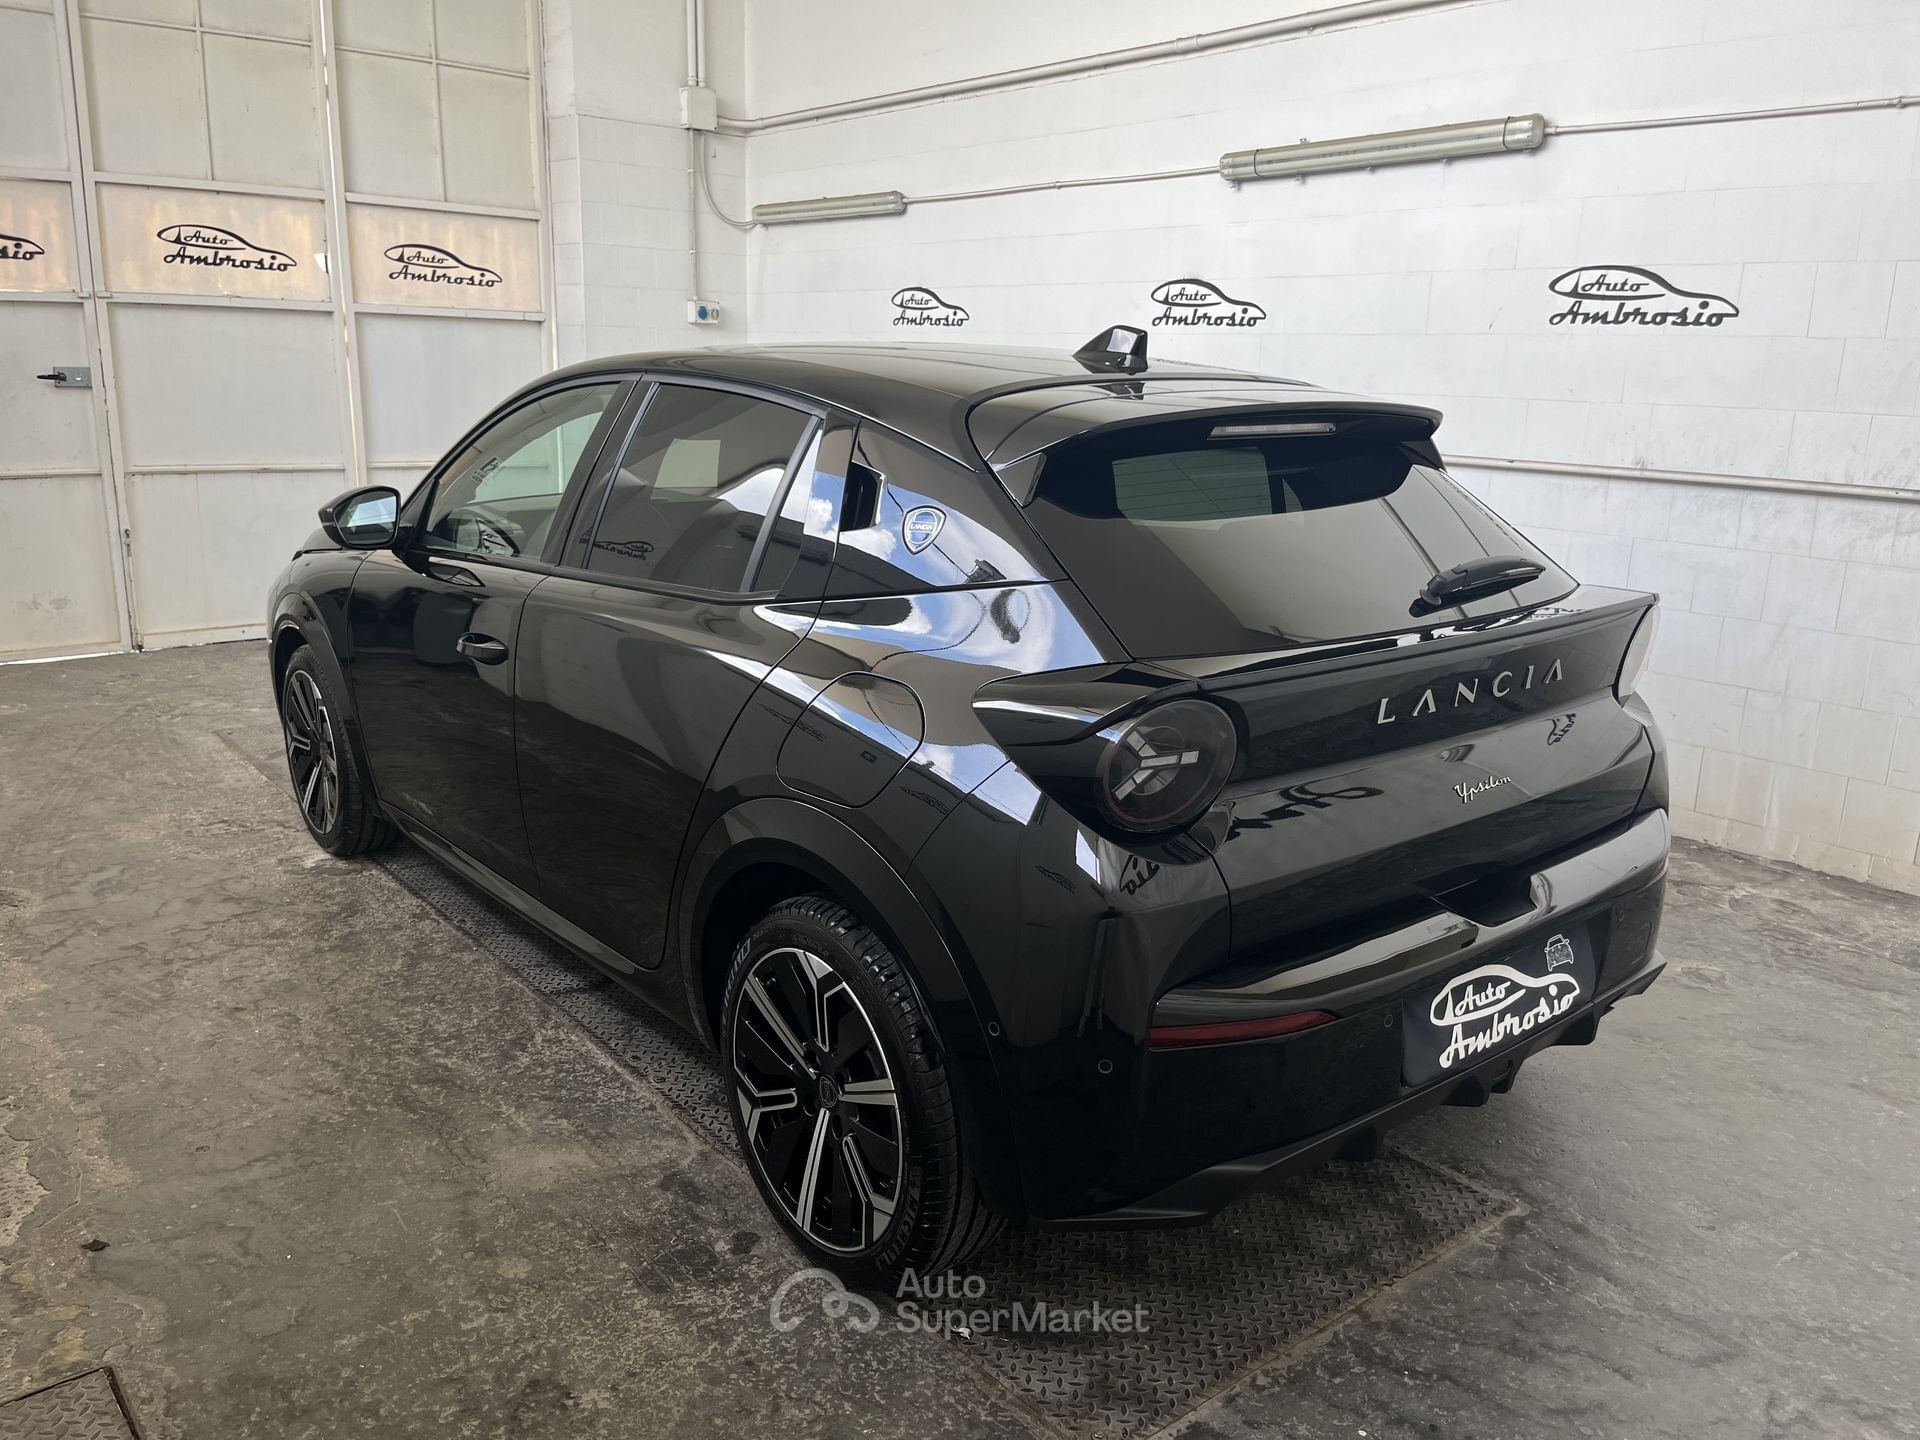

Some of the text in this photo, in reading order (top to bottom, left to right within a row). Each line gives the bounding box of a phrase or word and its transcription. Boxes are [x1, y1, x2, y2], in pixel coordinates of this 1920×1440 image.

[183, 230, 233, 246] Auto
[163, 246, 292, 272] Ambrosio
[406, 251, 449, 265] Auto
[388, 265, 498, 287] Ambrosio
[1580, 273, 1650, 292] Auto
[904, 293, 932, 306] Auto
[1170, 287, 1212, 302] Auto
[892, 309, 965, 327] Ambrosio
[1151, 306, 1259, 327] Ambrosio
[1549, 300, 1728, 327] Ambrosio
[1376, 658, 1564, 725] LANCIA
[1453, 775, 1512, 804] Ypsilon
[1454, 981, 1511, 1016] Auto
[1438, 984, 1578, 1069] Ambrosio
